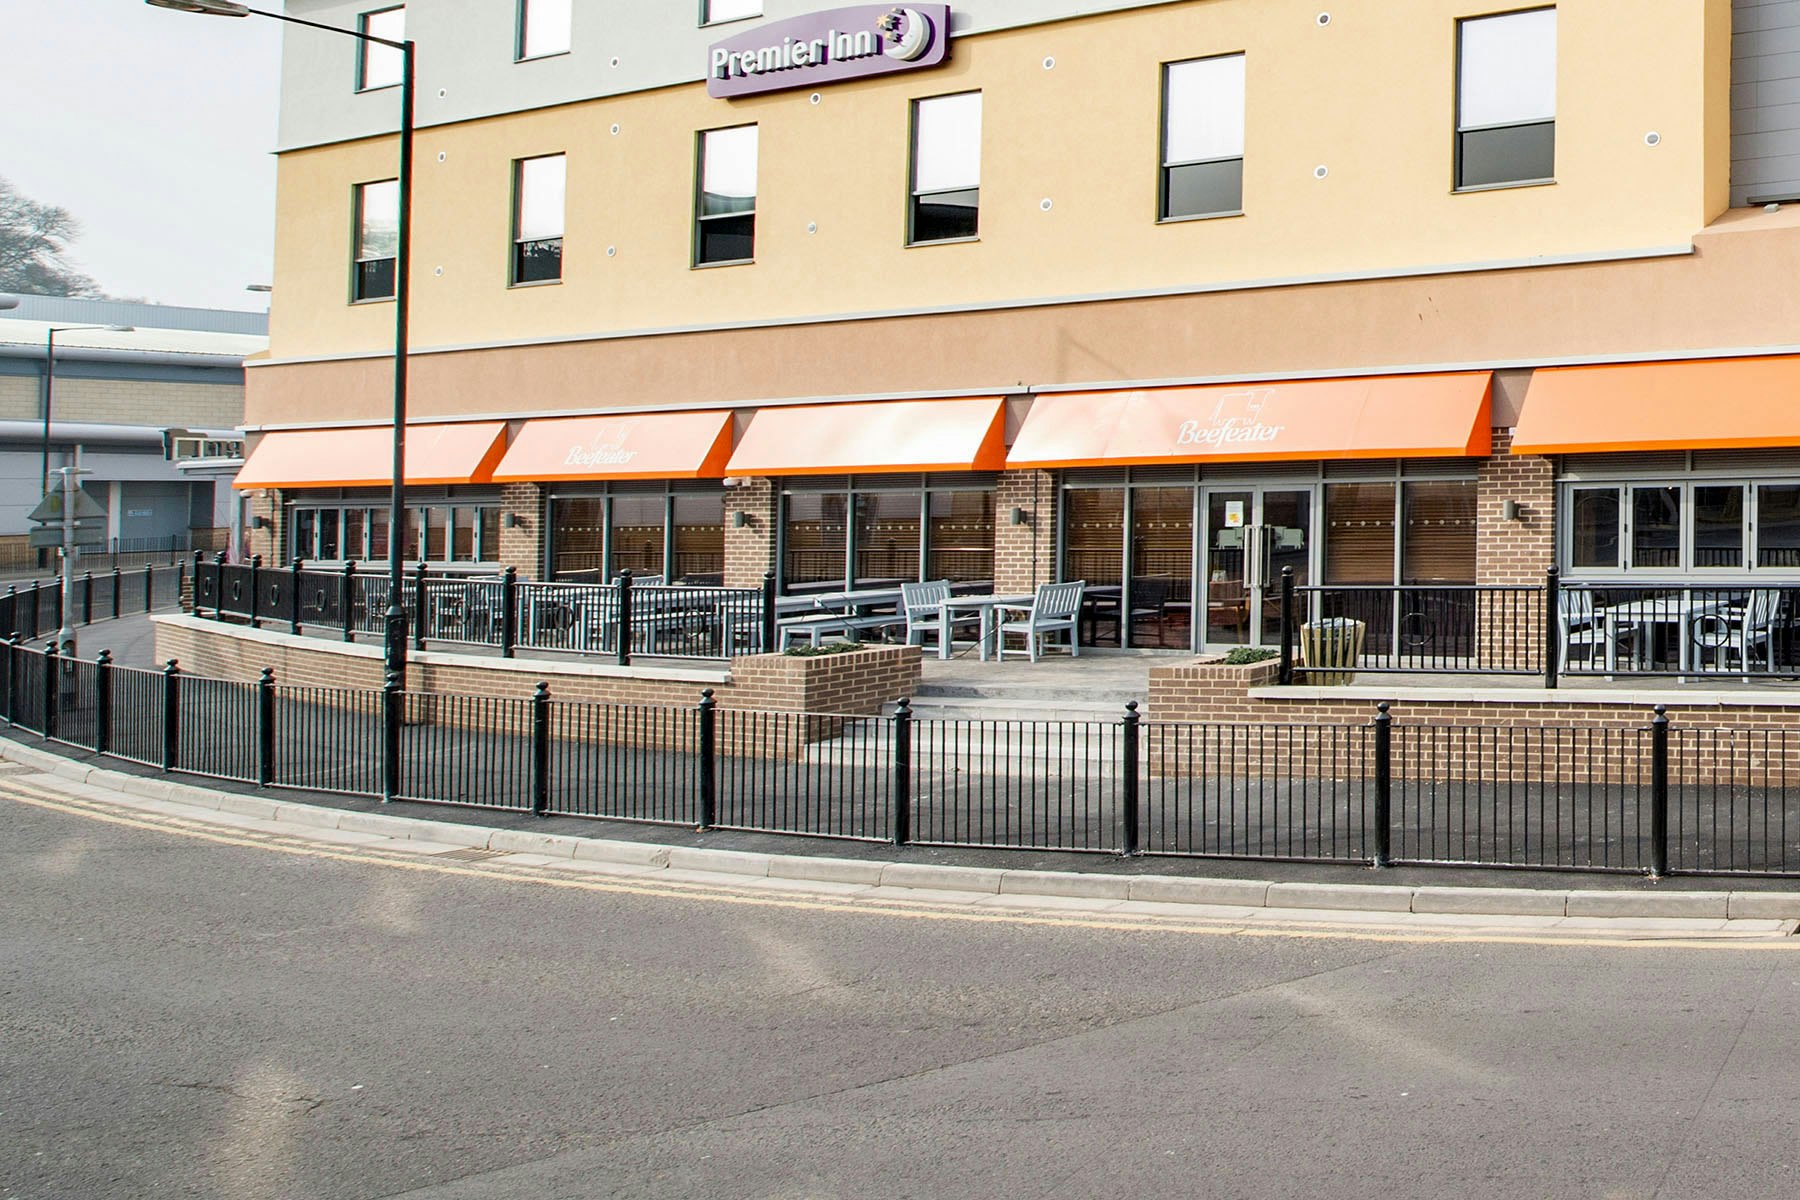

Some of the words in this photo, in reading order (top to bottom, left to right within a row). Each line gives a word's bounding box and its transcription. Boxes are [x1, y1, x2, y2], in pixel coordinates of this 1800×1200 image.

[711, 36, 824, 79] Premier
[828, 29, 875, 61] Inn
[1176, 417, 1285, 448] Beefeater
[563, 445, 638, 468] Beefeater
